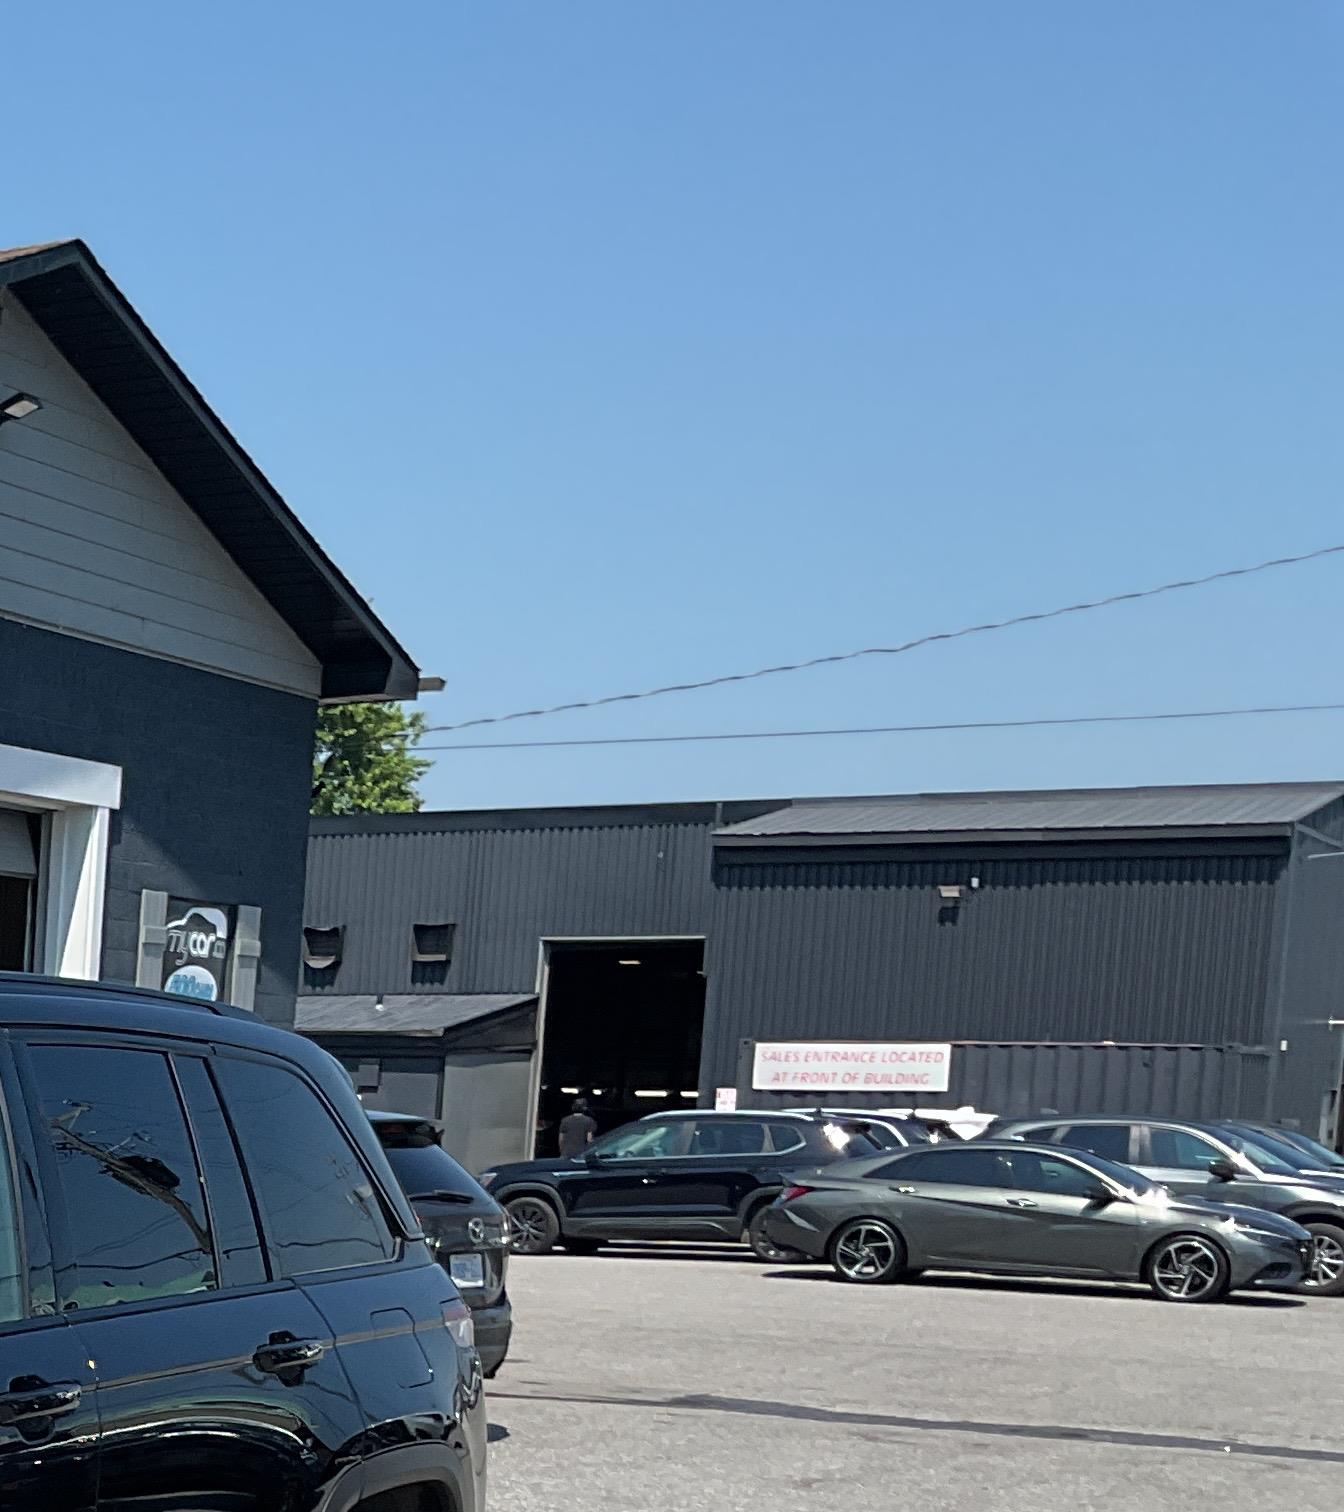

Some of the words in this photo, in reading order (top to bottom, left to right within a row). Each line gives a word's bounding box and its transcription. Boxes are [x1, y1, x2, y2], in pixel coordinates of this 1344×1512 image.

[761, 1050, 800, 1063] SALES
[804, 1051, 877, 1063] ENTRANCE
[881, 1051, 945, 1064] LOCATED
[771, 1071, 789, 1083] AT
[791, 1071, 838, 1084] FRONT
[841, 1072, 861, 1084] OF
[863, 1072, 930, 1085] BUILDING
